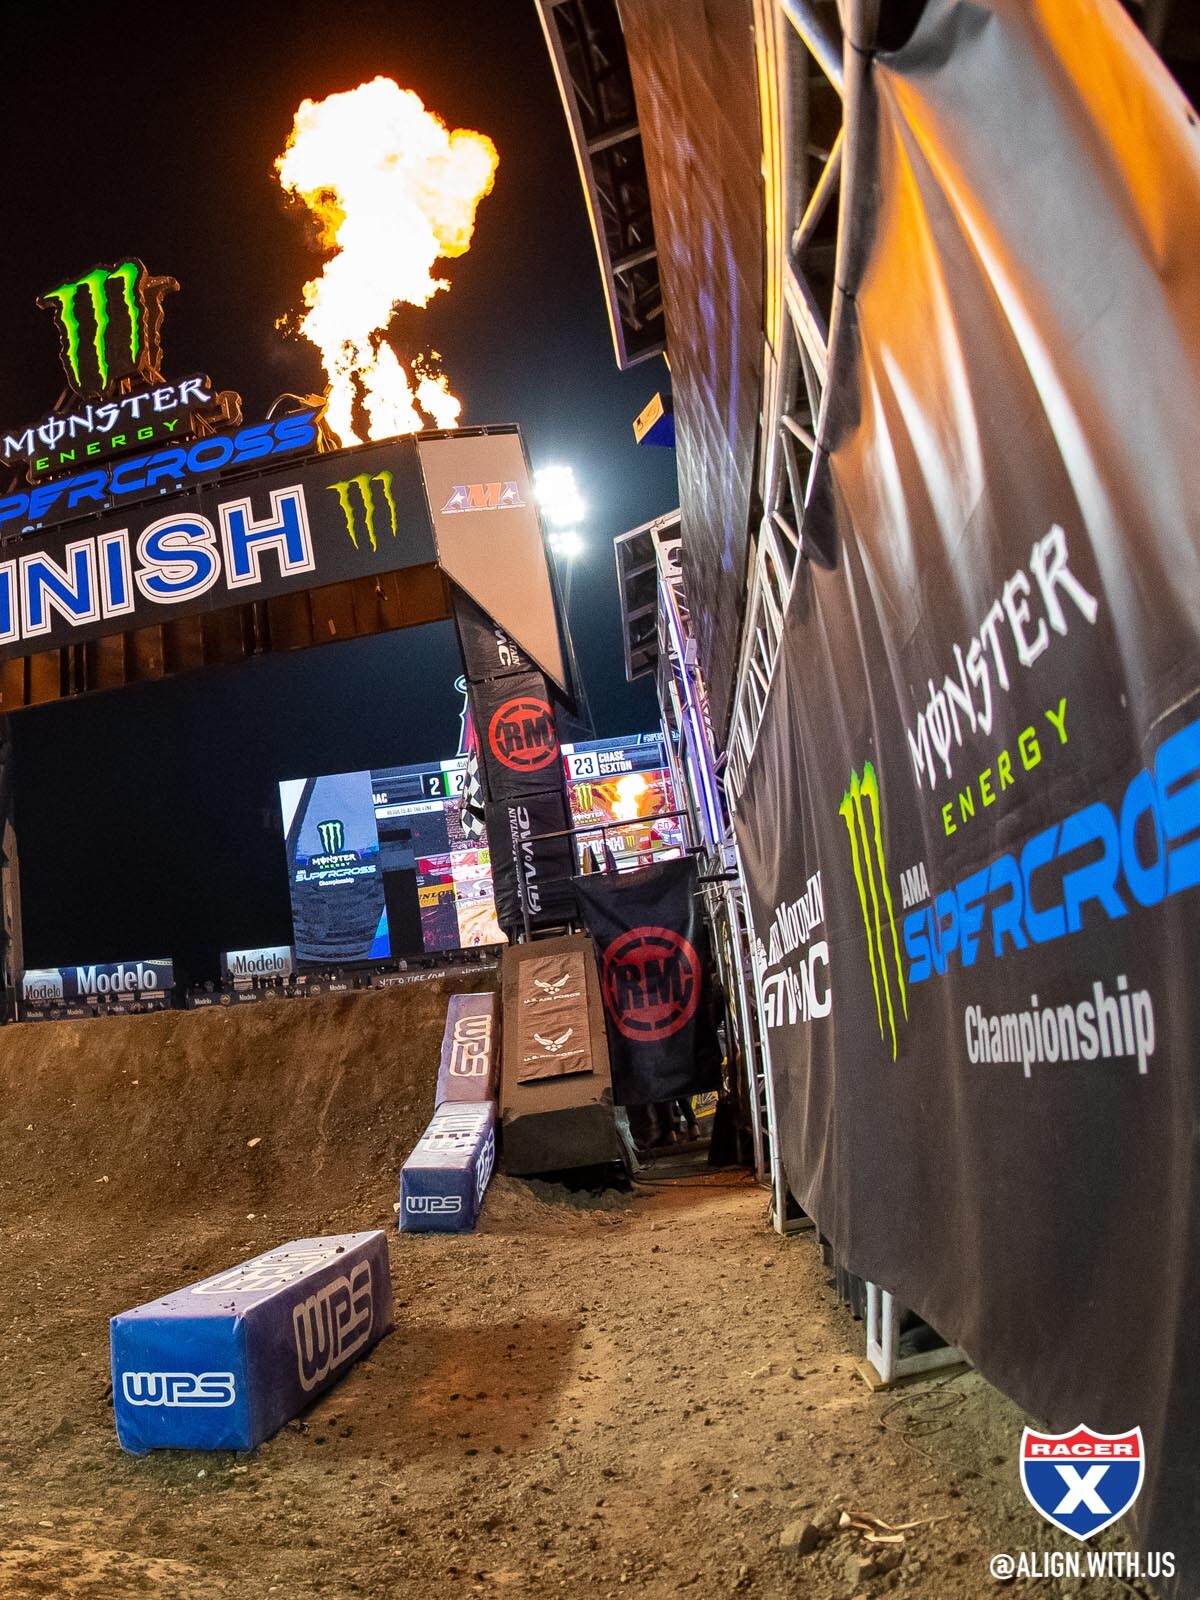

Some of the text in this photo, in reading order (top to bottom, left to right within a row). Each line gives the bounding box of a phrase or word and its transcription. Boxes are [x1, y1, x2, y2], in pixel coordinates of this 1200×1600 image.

[36, 419, 178, 471] ENERGY
[440, 481, 527, 511] AMA
[574, 750, 625, 776] 23 CHASE
[600, 760, 633, 775] SEXTON
[941, 698, 1068, 836] ENERGY
[429, 776, 441, 796] 2
[295, 865, 377, 882] SUPERCROSS
[899, 862, 930, 909] AMA
[235, 953, 284, 973] Modelo
[25, 984, 61, 1000] Modelo
[76, 963, 158, 995] Modelo
[964, 975, 1156, 1077] Championship
[449, 1014, 492, 1077] WPS
[405, 1195, 462, 1214] WPS
[292, 1259, 374, 1392] WPS
[121, 1371, 236, 1408] WPS
